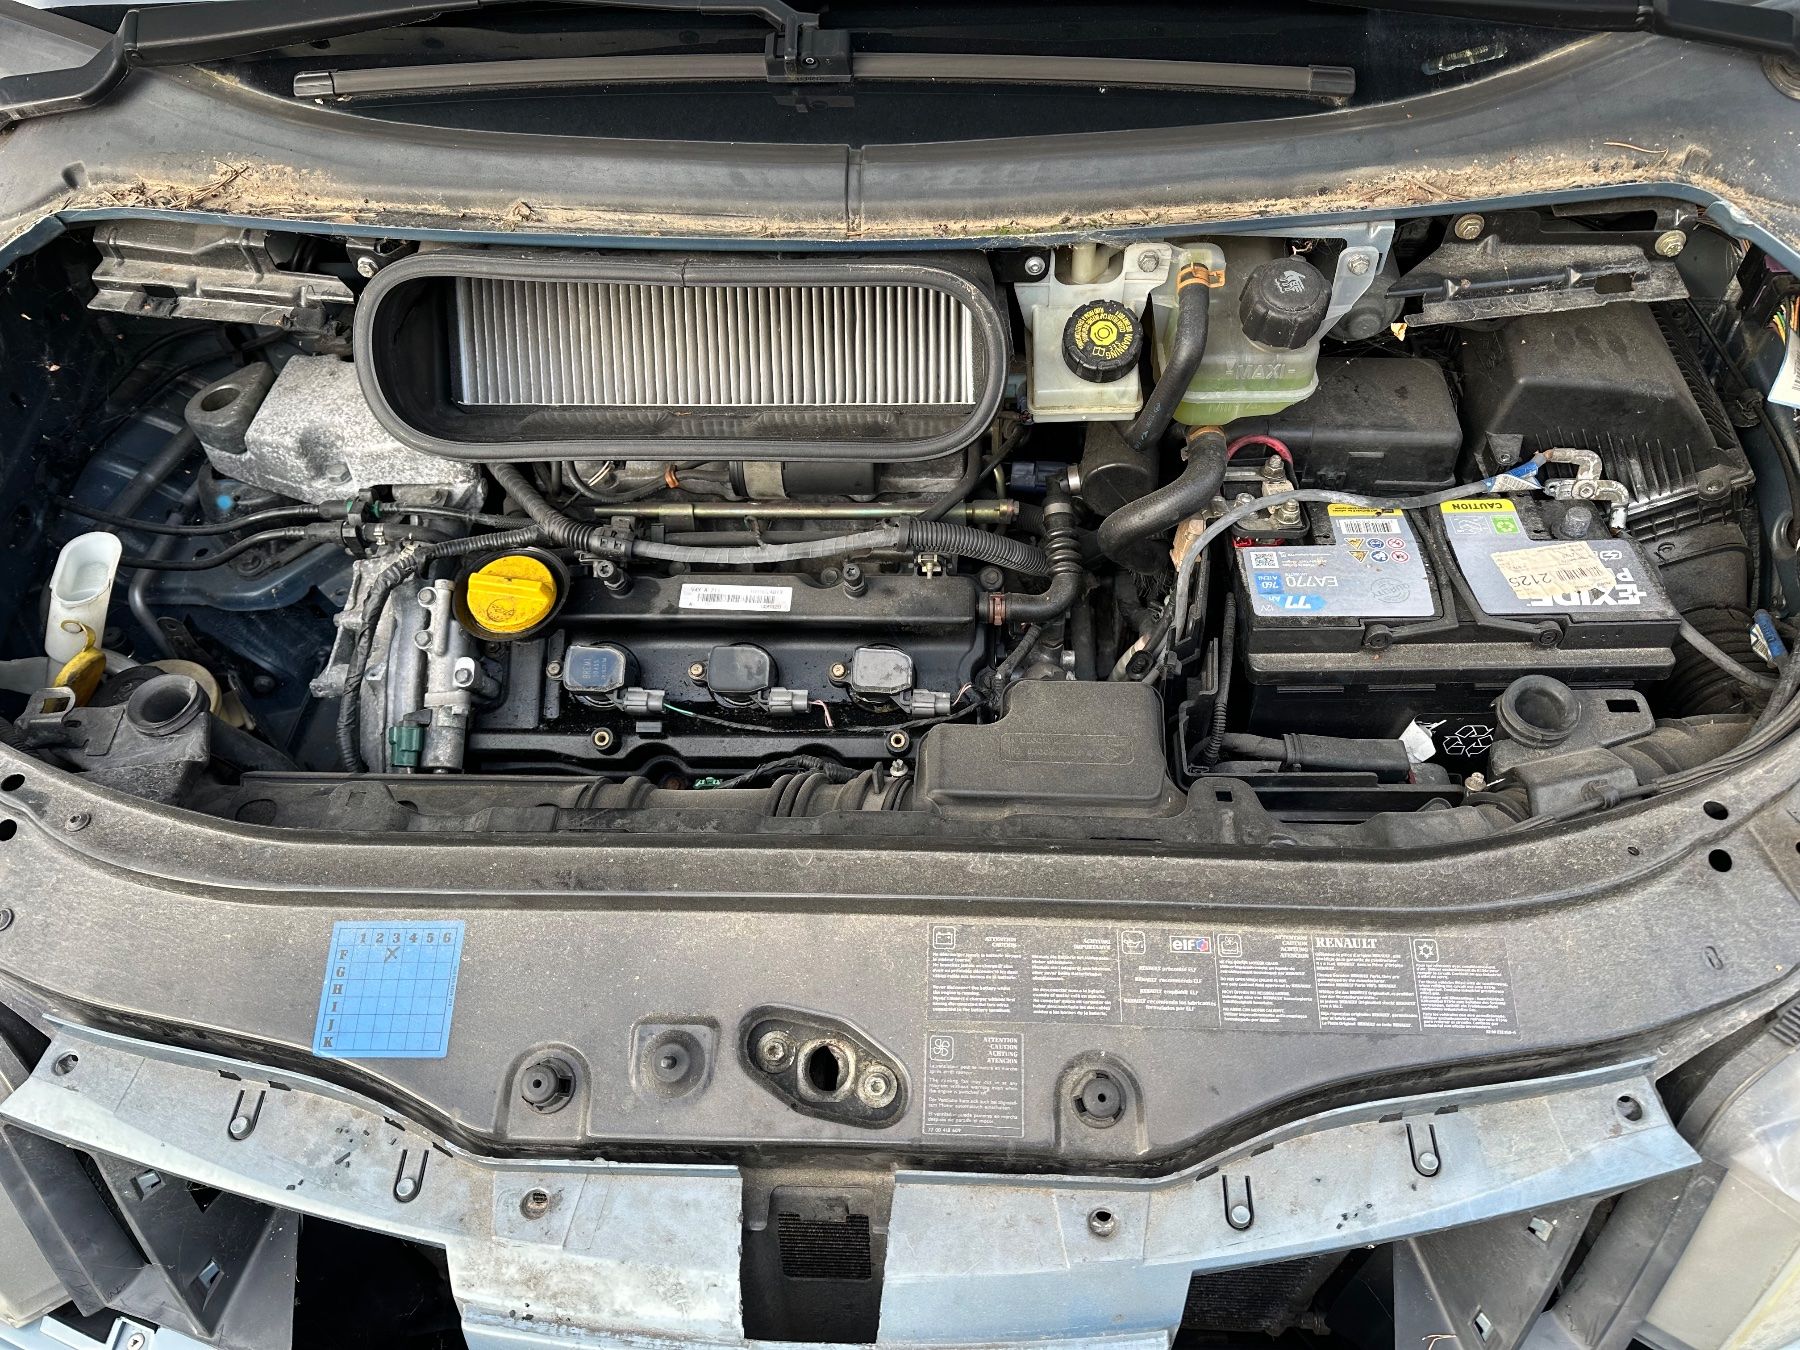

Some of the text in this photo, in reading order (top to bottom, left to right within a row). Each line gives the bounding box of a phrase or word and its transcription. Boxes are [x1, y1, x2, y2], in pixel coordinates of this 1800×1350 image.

[1106, 334, 1133, 359] WARNING
[1109, 342, 1120, 351] SEE
[1236, 364, 1285, 379] MAXI
[1286, 576, 1338, 587] EA770
[1509, 572, 1551, 587] 2125
[1285, 596, 1311, 608] 77
[360, 933, 451, 943] 1 2 3 4 5 6
[1315, 937, 1377, 948] RENAULT
[339, 950, 348, 960] F
[336, 967, 346, 977] G
[332, 984, 343, 994] H
[331, 1002, 338, 1012] I
[328, 1019, 335, 1031] J
[323, 1037, 333, 1047] K
